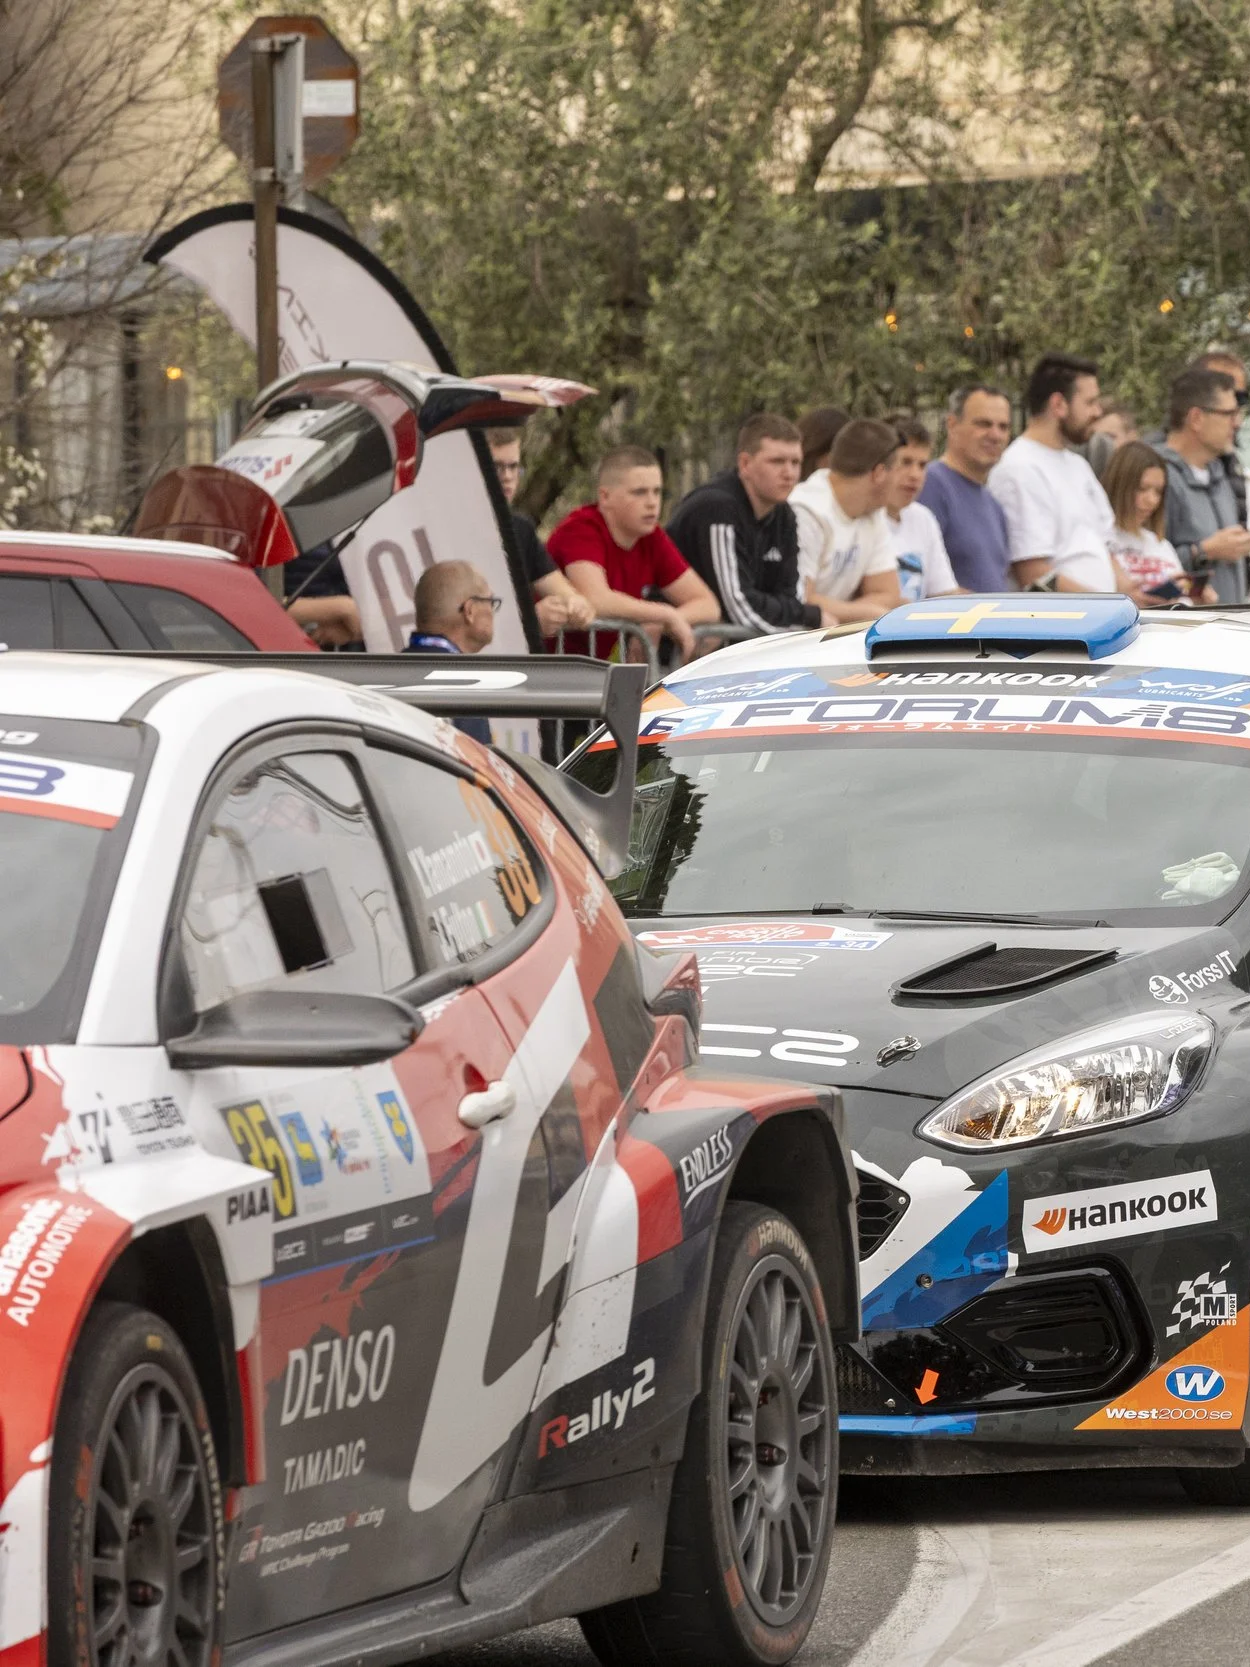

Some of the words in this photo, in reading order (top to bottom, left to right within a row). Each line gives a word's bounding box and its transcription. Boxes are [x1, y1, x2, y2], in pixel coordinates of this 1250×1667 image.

[1176, 962, 1224, 993] Forss
[1215, 949, 1238, 977] IT
[679, 1123, 733, 1194] ENDLESS
[226, 1186, 272, 1226] PIAA
[0, 1198, 63, 1297] anasonic
[6, 1204, 94, 1328] AUTOMOTIVE
[280, 1323, 396, 1427] DENSO
[1175, 1371, 1222, 1397] W
[537, 1356, 656, 1461] Rally2
[1105, 1407, 1233, 1420] West2000.se
[283, 1437, 367, 1496] TAMADIC
